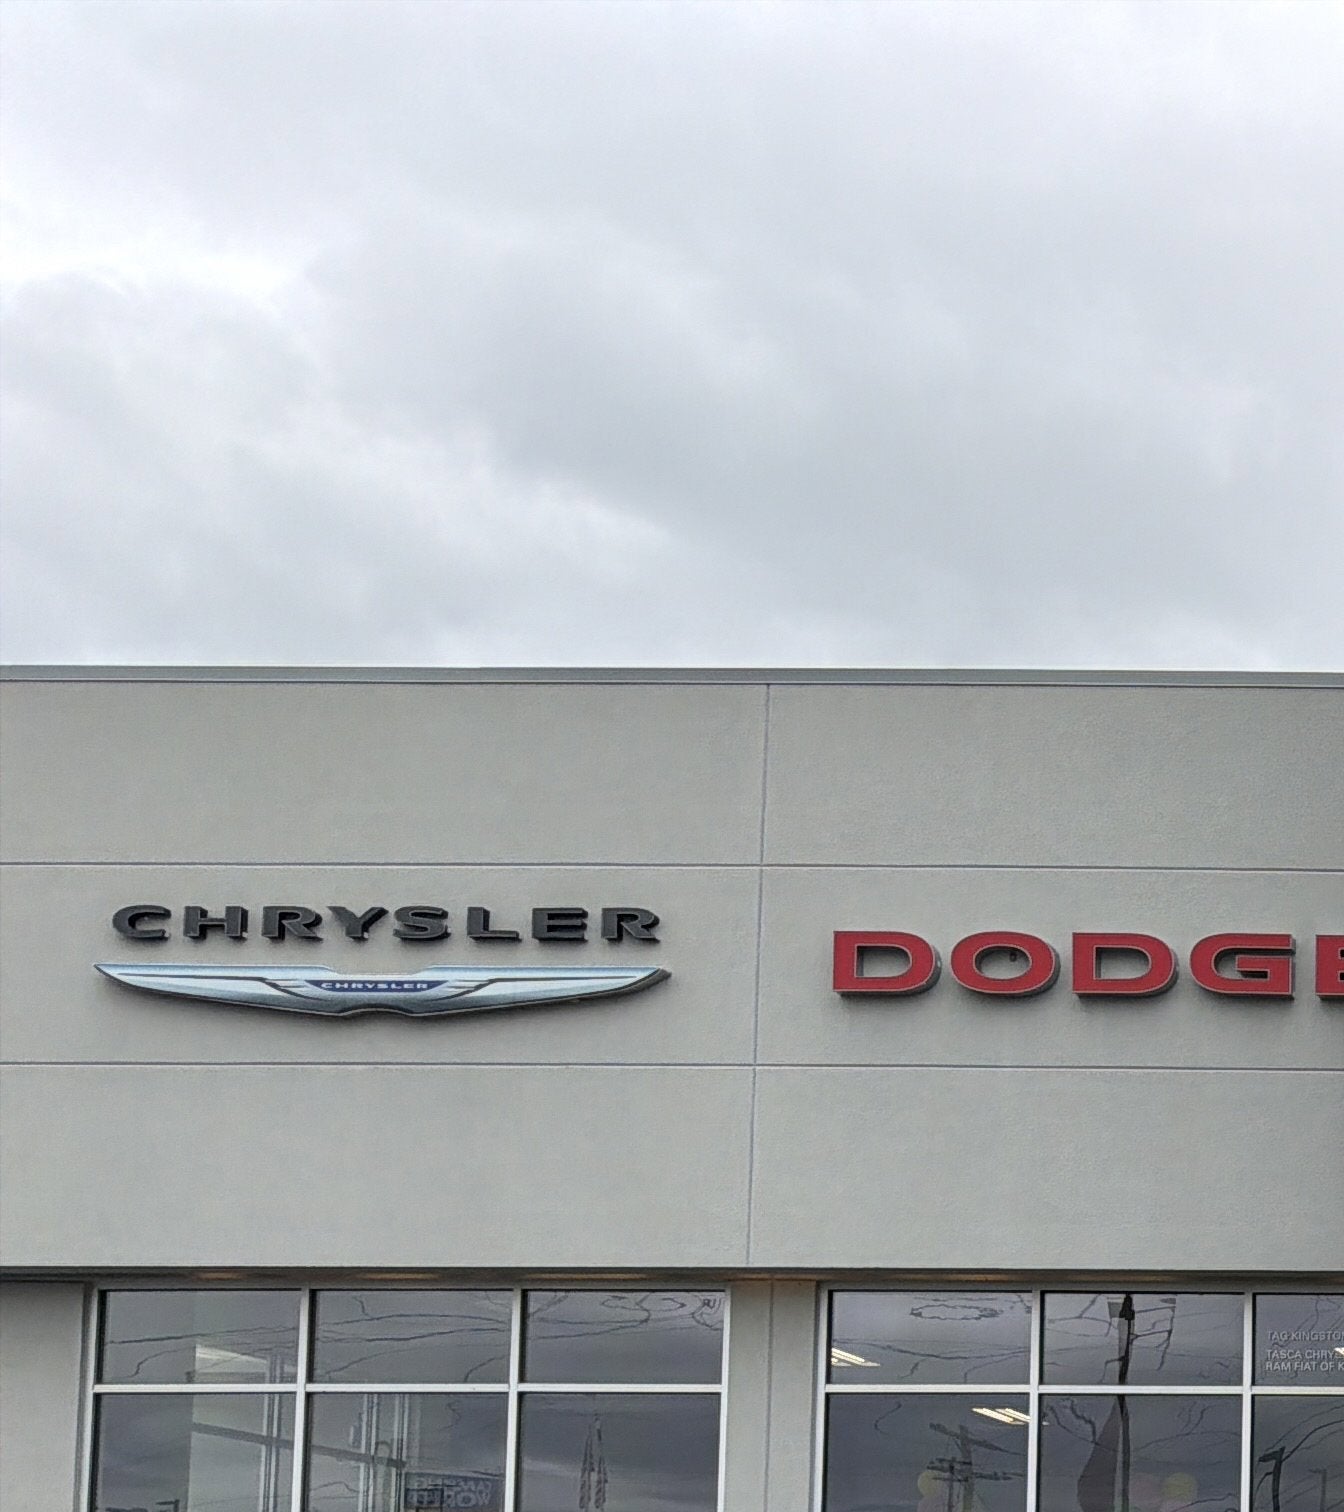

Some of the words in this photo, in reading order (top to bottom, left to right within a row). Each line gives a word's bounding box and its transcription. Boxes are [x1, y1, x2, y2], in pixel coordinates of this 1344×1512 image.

[111, 904, 661, 944] CHRYSLER
[320, 982, 429, 990] CHRYSLER
[1266, 1349, 1302, 1360] TASCA
[1265, 1361, 1291, 1372] RAM
[1294, 1361, 1318, 1372] FIAT
[1320, 1361, 1335, 1372] OF
